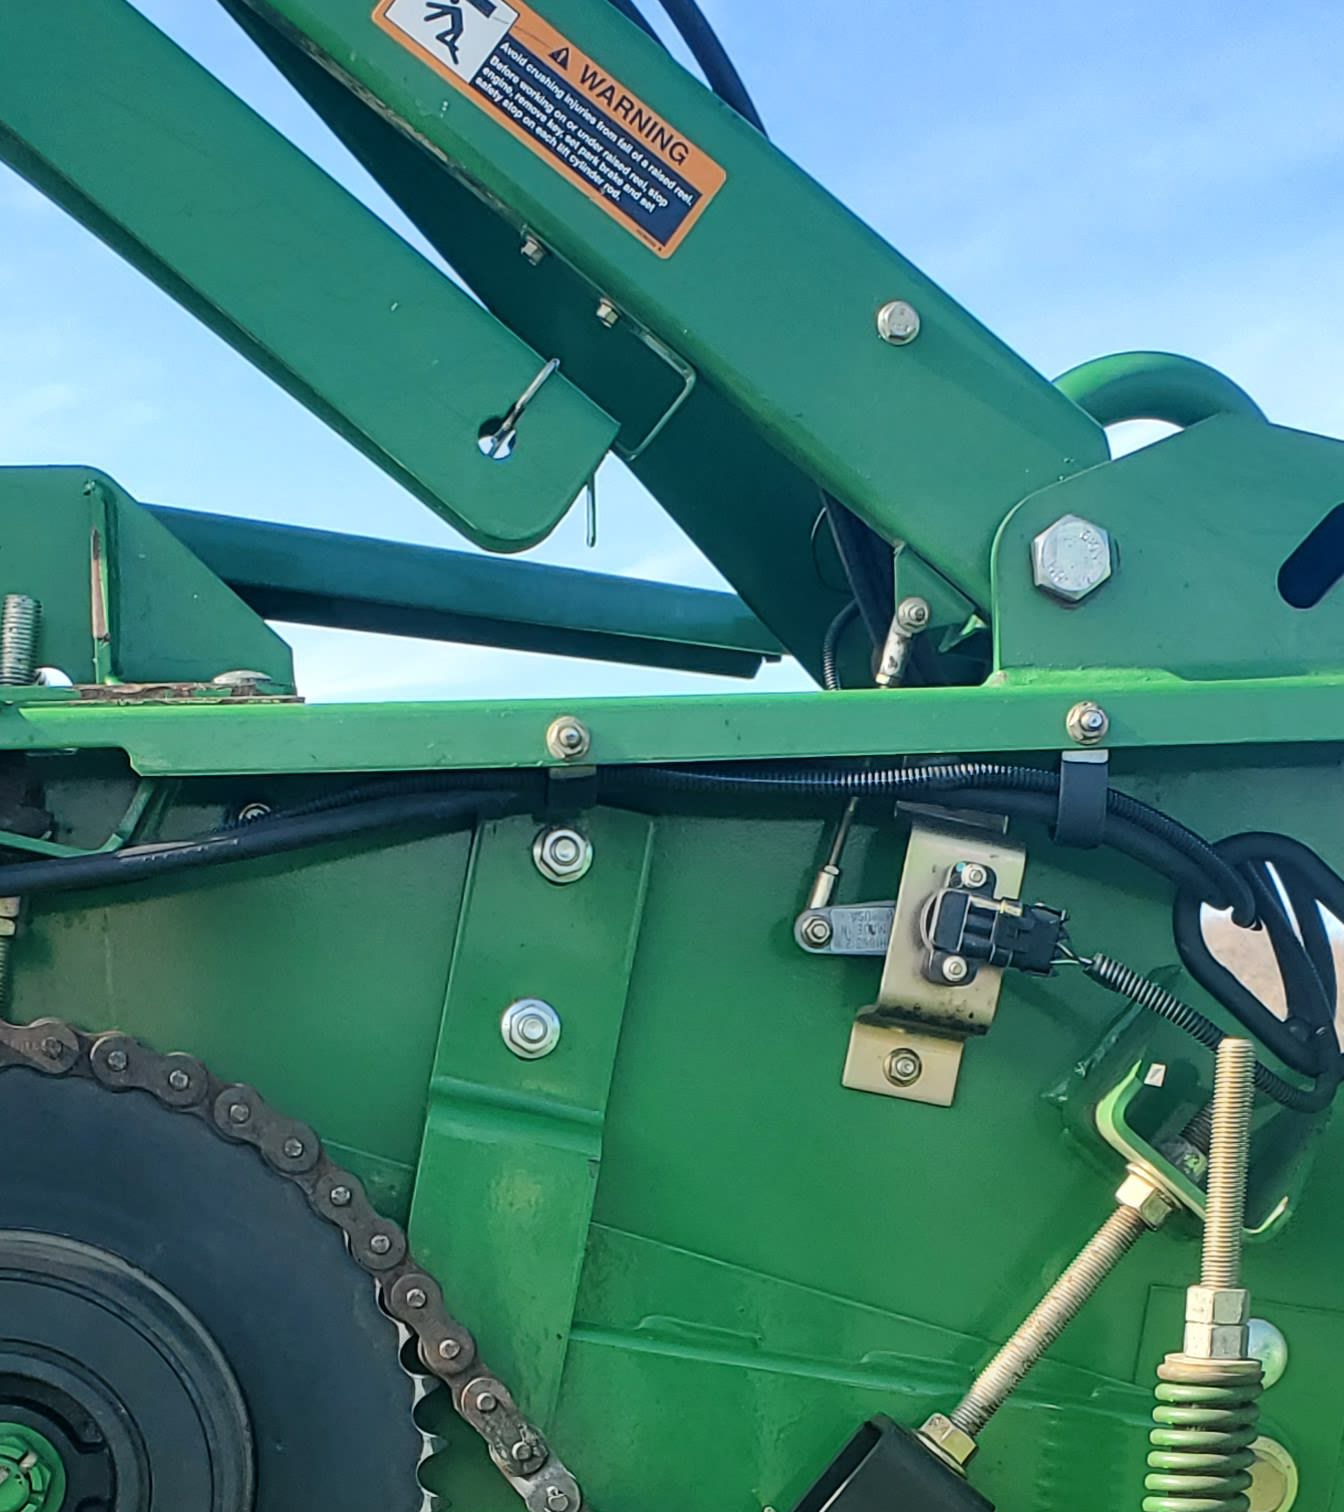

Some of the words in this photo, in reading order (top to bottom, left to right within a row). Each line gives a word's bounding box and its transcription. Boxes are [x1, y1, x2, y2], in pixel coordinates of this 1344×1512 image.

[475, 76, 504, 103] safety
[502, 99, 524, 119] stop
[522, 116, 536, 129] on
[535, 126, 557, 147] each
[556, 142, 571, 158] lift
[569, 154, 605, 185] cylinder
[602, 182, 621, 201] rod.
[482, 67, 514, 98] engine,
[514, 92, 548, 123] remove
[564, 134, 581, 150] set
[577, 146, 600, 167] park
[598, 161, 624, 186] brake
[622, 183, 642, 201] and
[639, 197, 656, 213] set
[489, 55, 520, 84] Before
[519, 81, 555, 114] working
[553, 110, 567, 123] on
[566, 120, 578, 132] or
[577, 128, 604, 153] under
[602, 150, 632, 176] raised
[628, 172, 649, 193] reel,
[647, 187, 668, 207] stop
[499, 42, 528, 67] Avoid
[526, 63, 565, 100] crushing
[596, 120, 618, 142] from
[616, 137, 634, 154] fall
[631, 151, 644, 162] of
[640, 159, 649, 169] a
[647, 164, 677, 190] raised
[673, 186, 693, 206] reel.
[579, 63, 689, 166] WARNING
